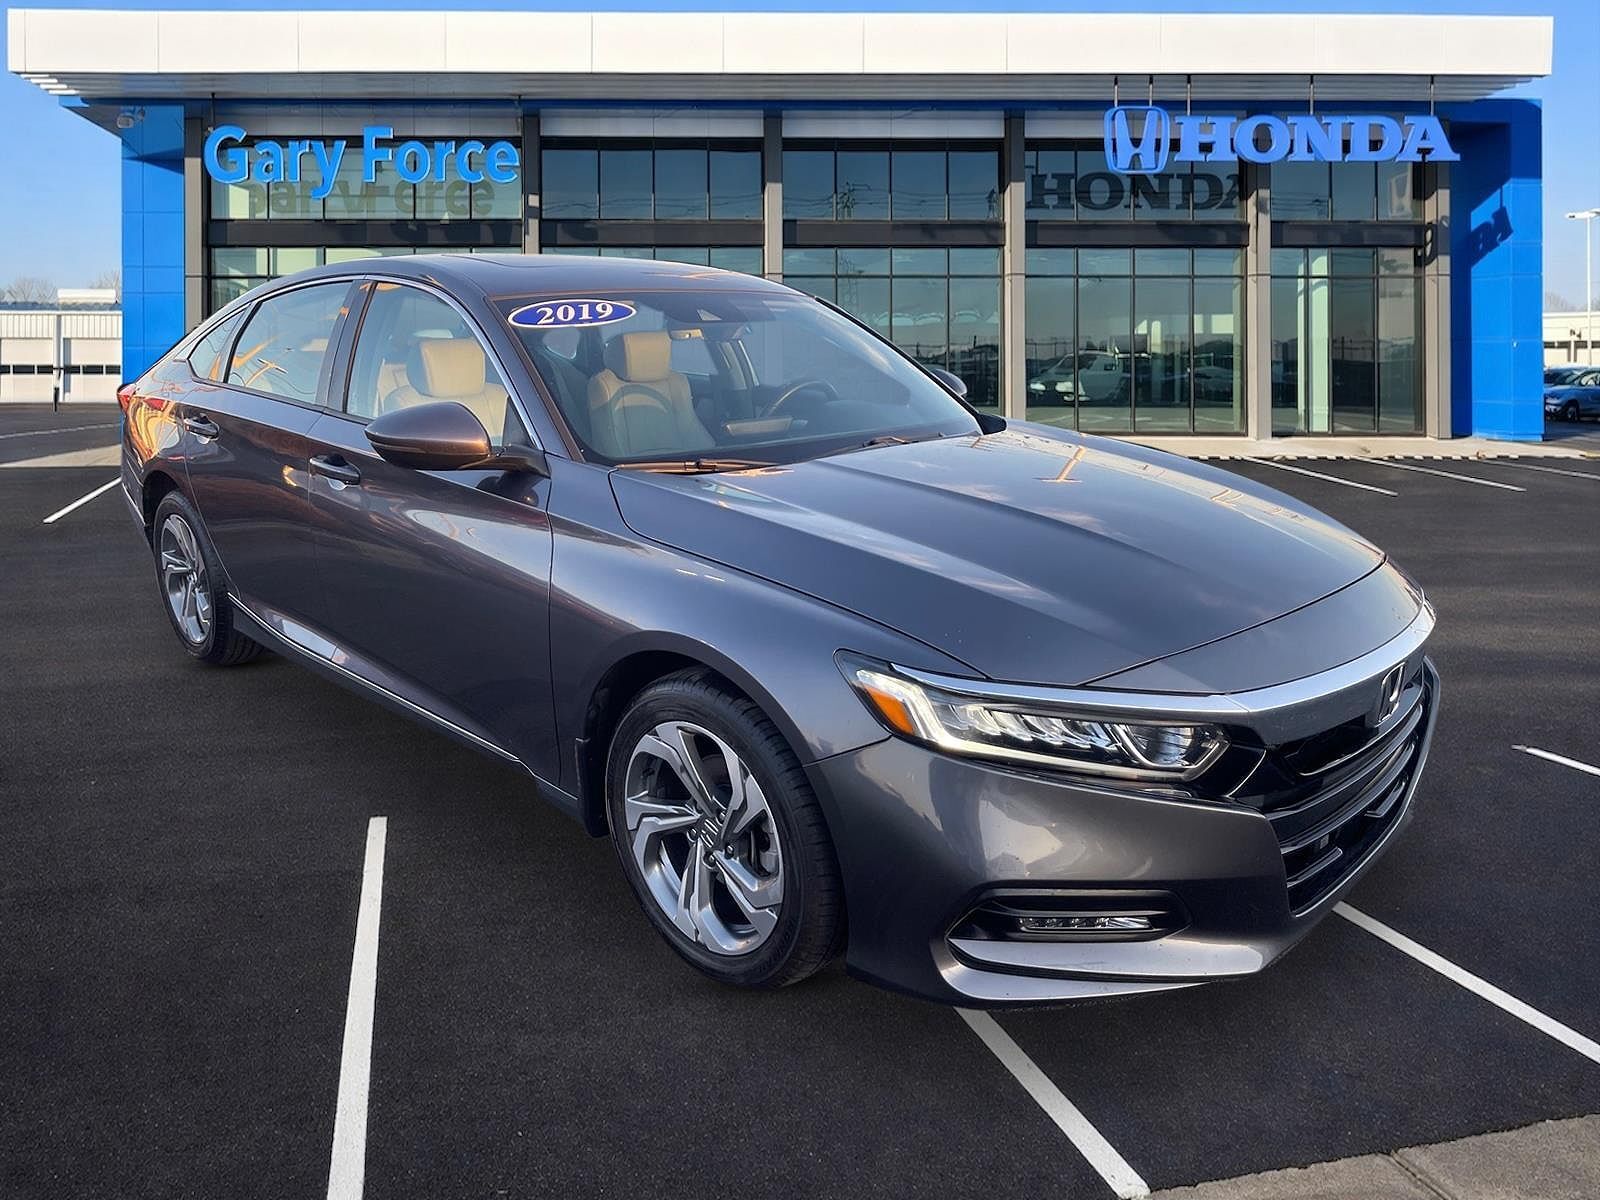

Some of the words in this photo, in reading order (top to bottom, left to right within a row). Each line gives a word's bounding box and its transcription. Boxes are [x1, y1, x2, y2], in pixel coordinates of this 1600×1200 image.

[204, 125, 347, 198] Gary
[362, 125, 520, 183] Force
[1174, 114, 1461, 163] HONDA
[536, 302, 613, 325] 2019
